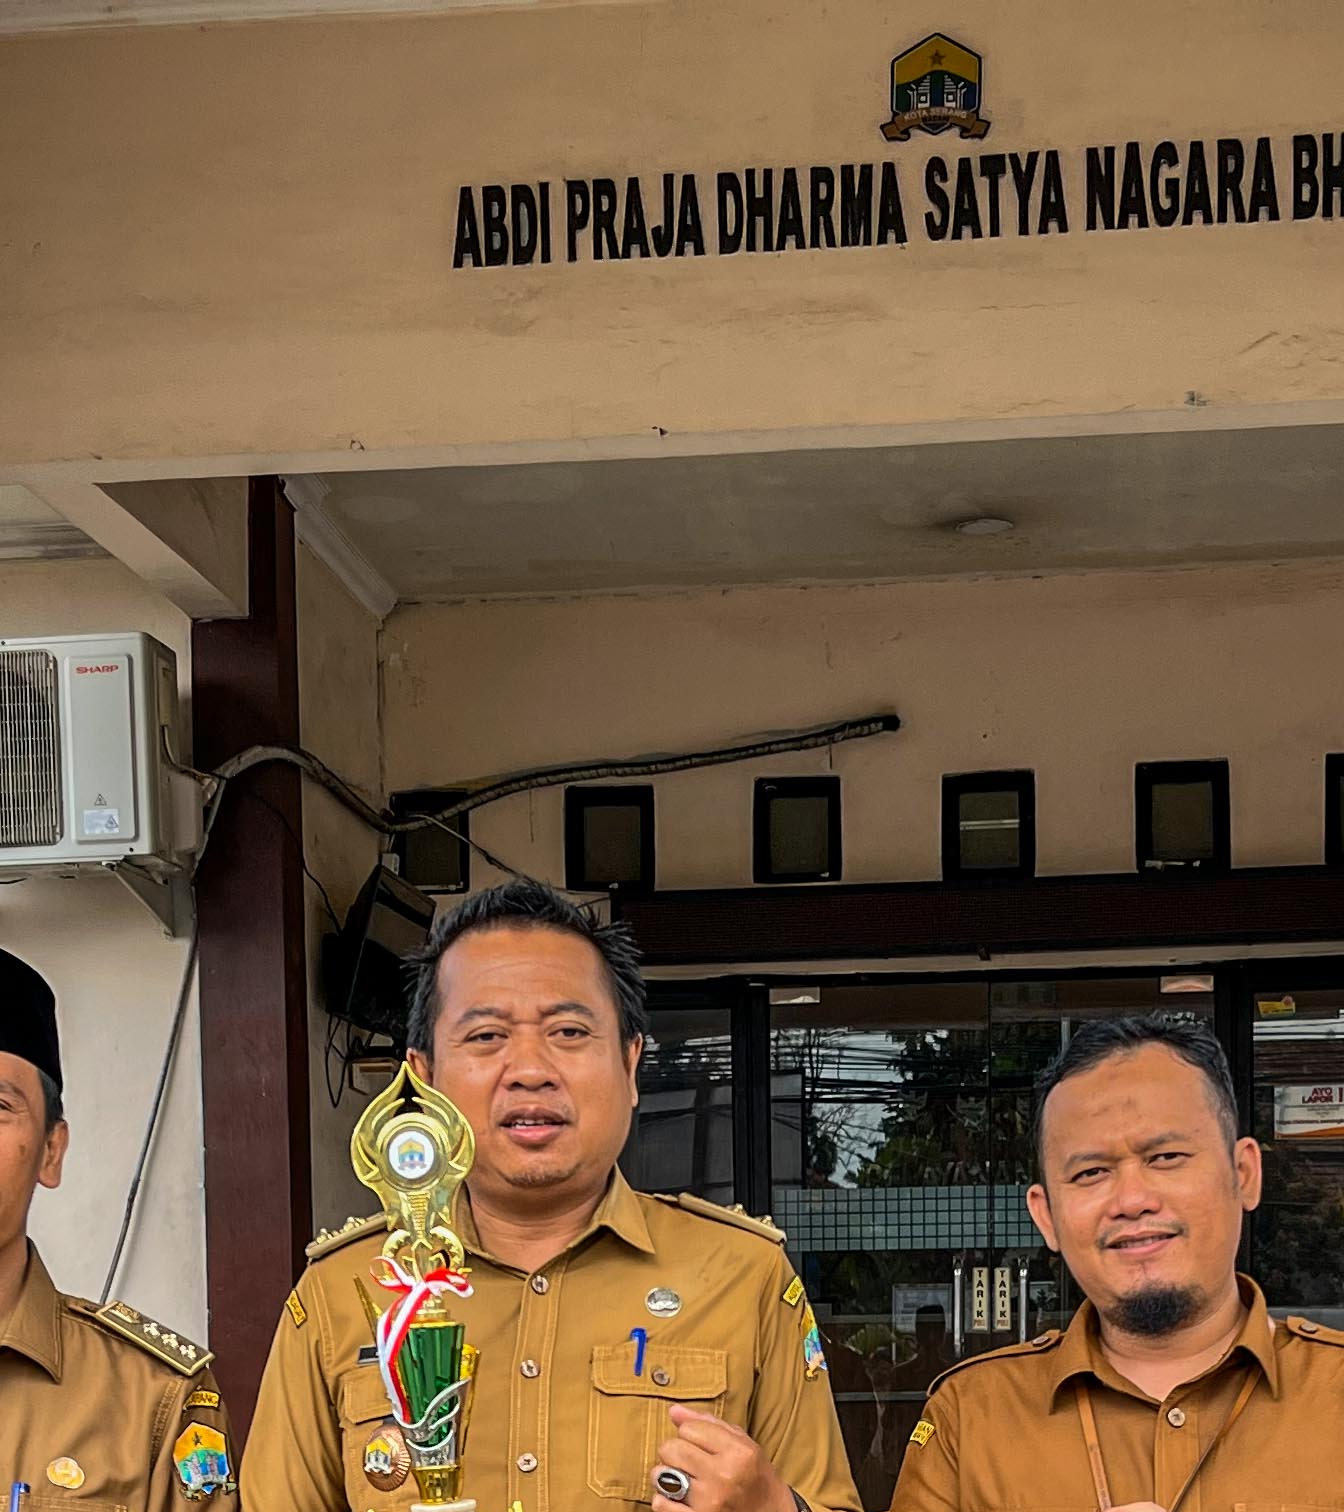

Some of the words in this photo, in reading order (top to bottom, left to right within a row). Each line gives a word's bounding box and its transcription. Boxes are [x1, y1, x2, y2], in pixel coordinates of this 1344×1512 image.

[453, 182, 551, 268] ABDI
[566, 173, 706, 263] PRAJA
[717, 162, 908, 256] DHARMA
[924, 149, 1069, 241] SATYA
[1086, 137, 1280, 231] NAGARA
[76, 664, 119, 674] SHARP
[1302, 1096, 1334, 1105] LAPOR
[1311, 1087, 1333, 1097] AYO
[976, 1270, 984, 1318] TARIK
[999, 1270, 1007, 1318] TARIK
